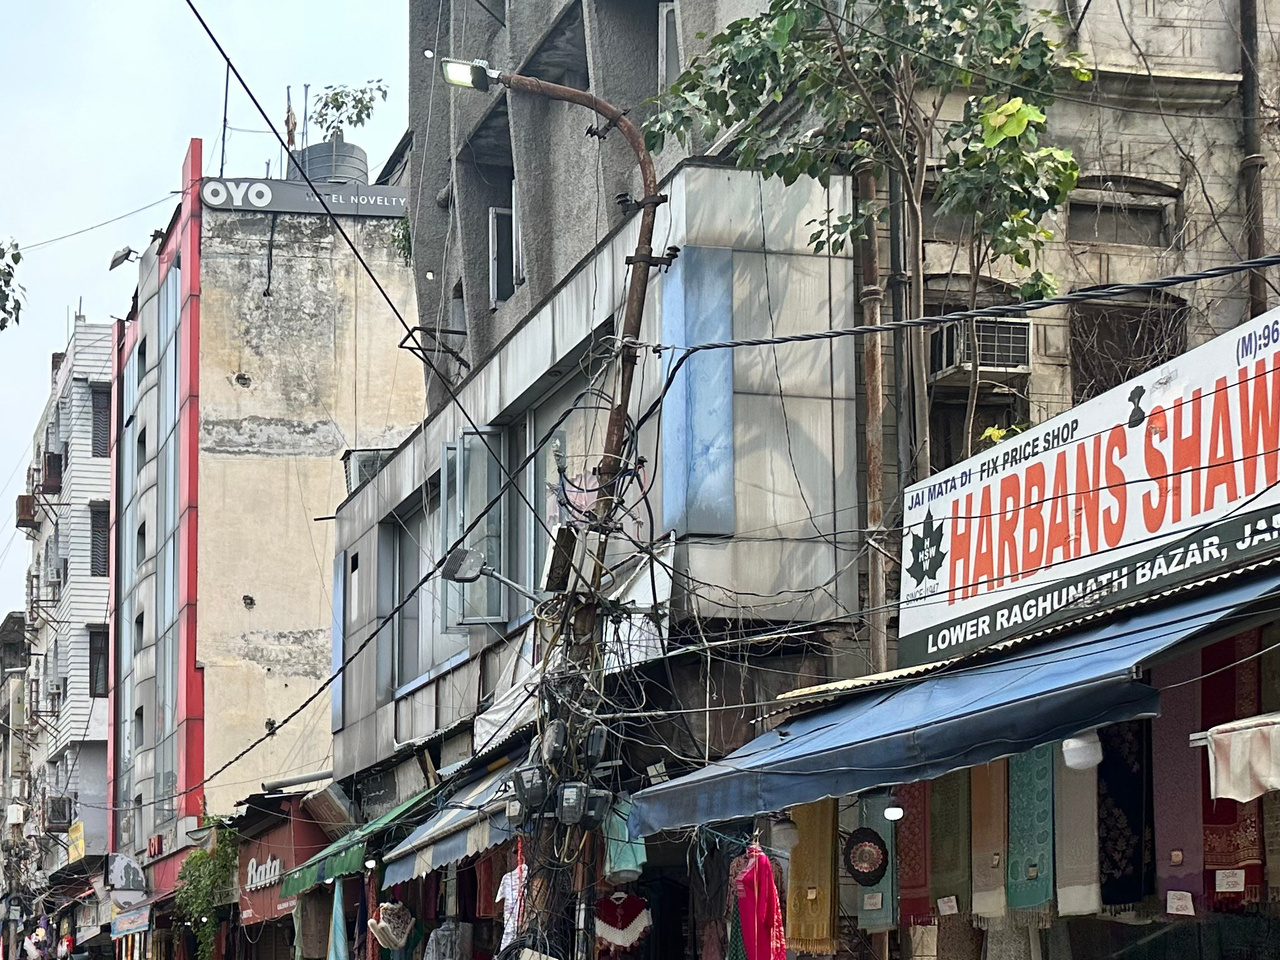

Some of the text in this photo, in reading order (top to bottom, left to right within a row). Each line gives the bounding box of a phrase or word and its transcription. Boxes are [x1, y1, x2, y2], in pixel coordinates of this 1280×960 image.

[202, 180, 272, 208] OYO
[350, 195, 407, 207] NOVELTY
[907, 417, 1080, 512] JAI MATA DI FIX PRICE SHOP
[948, 423, 1127, 606] HARBANS
[927, 613, 991, 654] LOWER
[996, 567, 1128, 631] RAGHUNATH
[1135, 535, 1228, 583] BAZAR,
[245, 852, 282, 886] Bata
